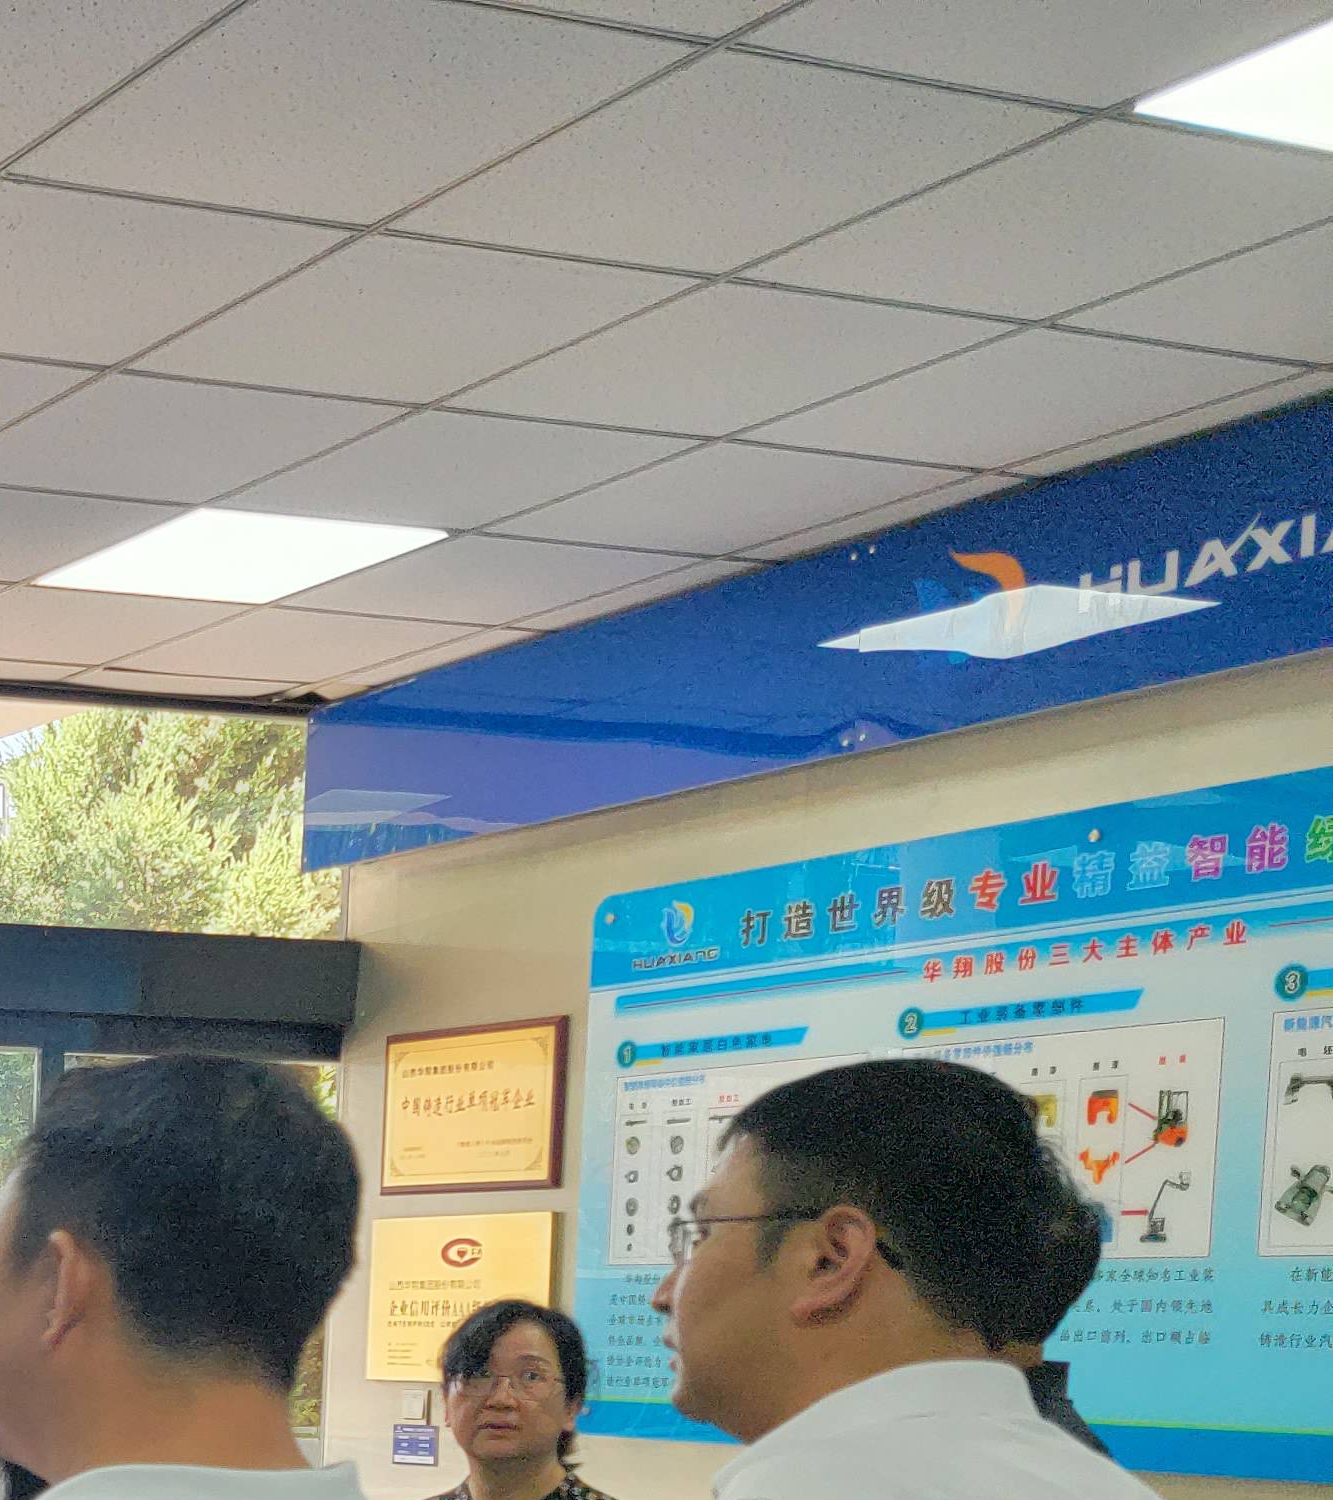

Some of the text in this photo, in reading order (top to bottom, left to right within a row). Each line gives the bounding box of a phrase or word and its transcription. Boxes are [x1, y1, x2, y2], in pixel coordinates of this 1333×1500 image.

[1078, 512, 1333, 614] HUAXI
[632, 948, 720, 970] HUAXIANG
[922, 918, 1247, 983] 华翔股份三大主体产业
[1284, 970, 1301, 994] 3
[904, 1012, 918, 1034] 2
